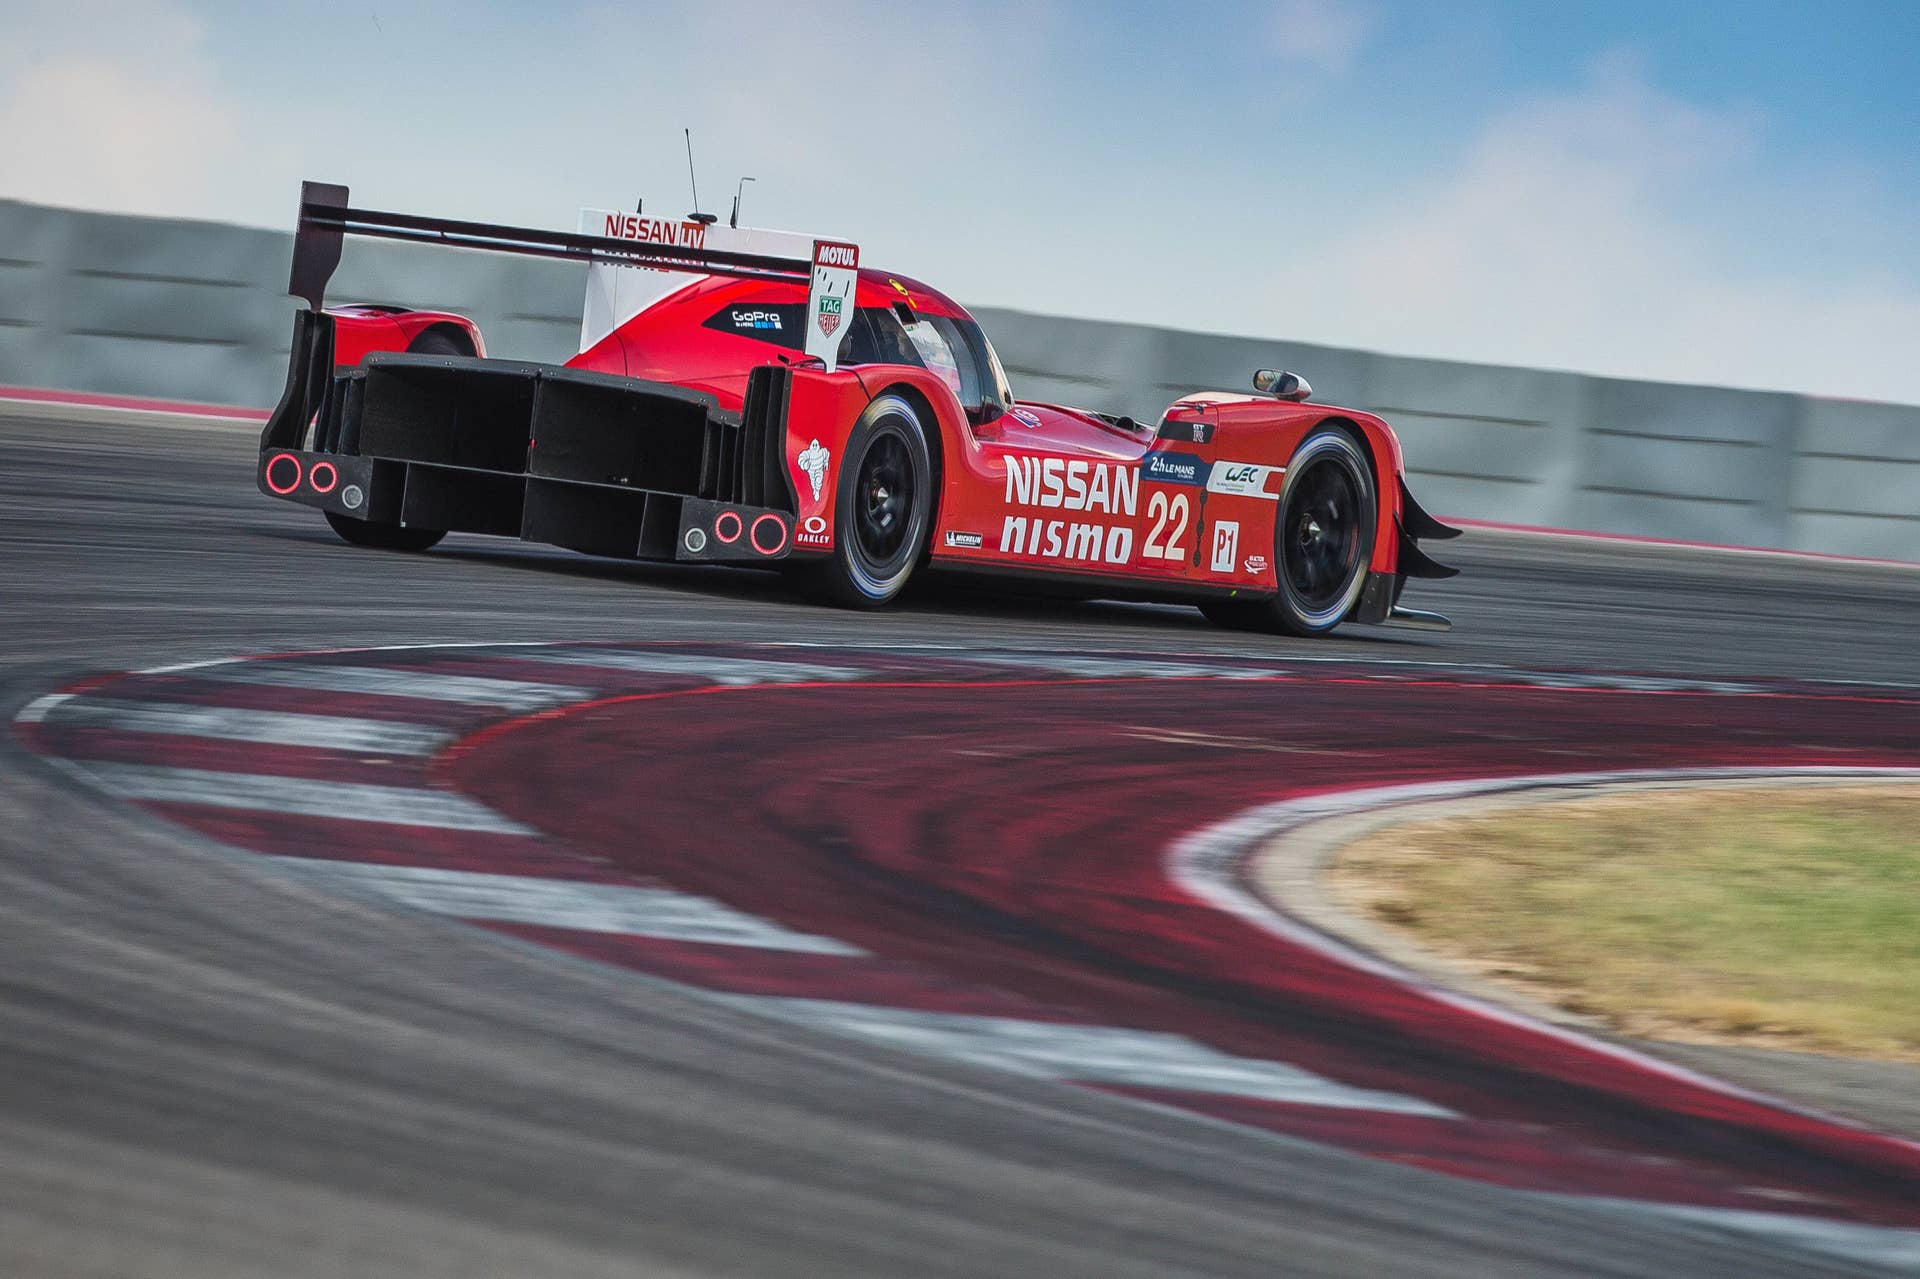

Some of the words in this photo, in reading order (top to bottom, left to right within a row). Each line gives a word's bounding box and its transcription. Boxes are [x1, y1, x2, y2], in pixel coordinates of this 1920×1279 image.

[605, 214, 677, 245] NISSAN
[681, 226, 704, 250] TV
[818, 246, 855, 267] MOTUL
[732, 311, 780, 322] GoPro
[822, 299, 840, 313] TAG
[819, 314, 840, 335] HEUER
[1003, 454, 1140, 516] NISSAN
[1225, 466, 1258, 483] WEC
[1142, 490, 1189, 561] 22
[797, 533, 830, 544] OAKLEY
[956, 535, 982, 545] MICHELIN
[1000, 516, 1133, 564] nismo
[1215, 529, 1235, 565] P1
